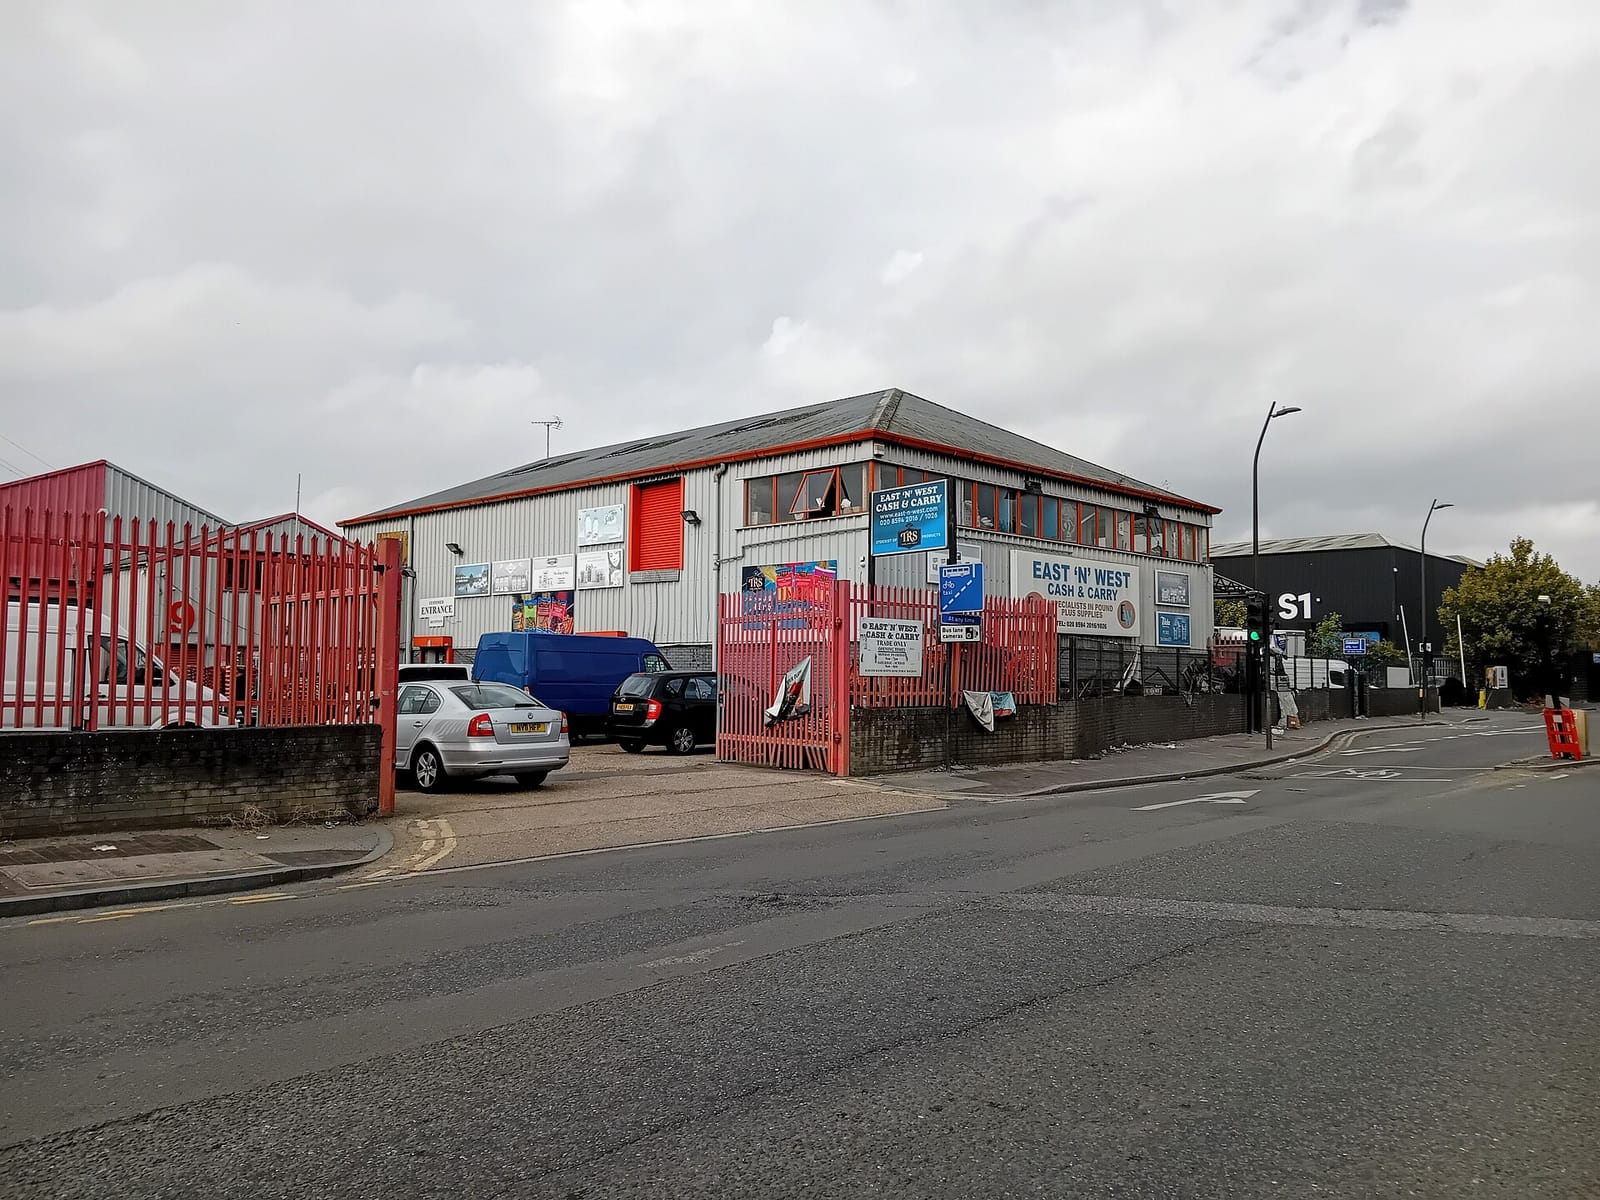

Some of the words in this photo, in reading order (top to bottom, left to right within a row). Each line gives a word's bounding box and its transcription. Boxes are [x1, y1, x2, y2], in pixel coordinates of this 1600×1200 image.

[880, 493, 900, 502] EAST
[902, 490, 912, 498] 'N'
[914, 486, 938, 496] WEST
[876, 501, 900, 512] CASH
[902, 500, 908, 508] &
[910, 494, 942, 507] CARRY
[900, 530, 918, 542] TRS
[1032, 560, 1070, 582] EAST
[1095, 568, 1130, 588] WEST
[1047, 583, 1074, 597] CASH
[1078, 586, 1084, 598] &
[1087, 587, 1118, 601] CARRY
[421, 605, 453, 615] ENTRANCE
[1058, 601, 1087, 610] ECIALISTS
[1279, 592, 1311, 619] S1
[1077, 610, 1103, 618] SUPPLIES
